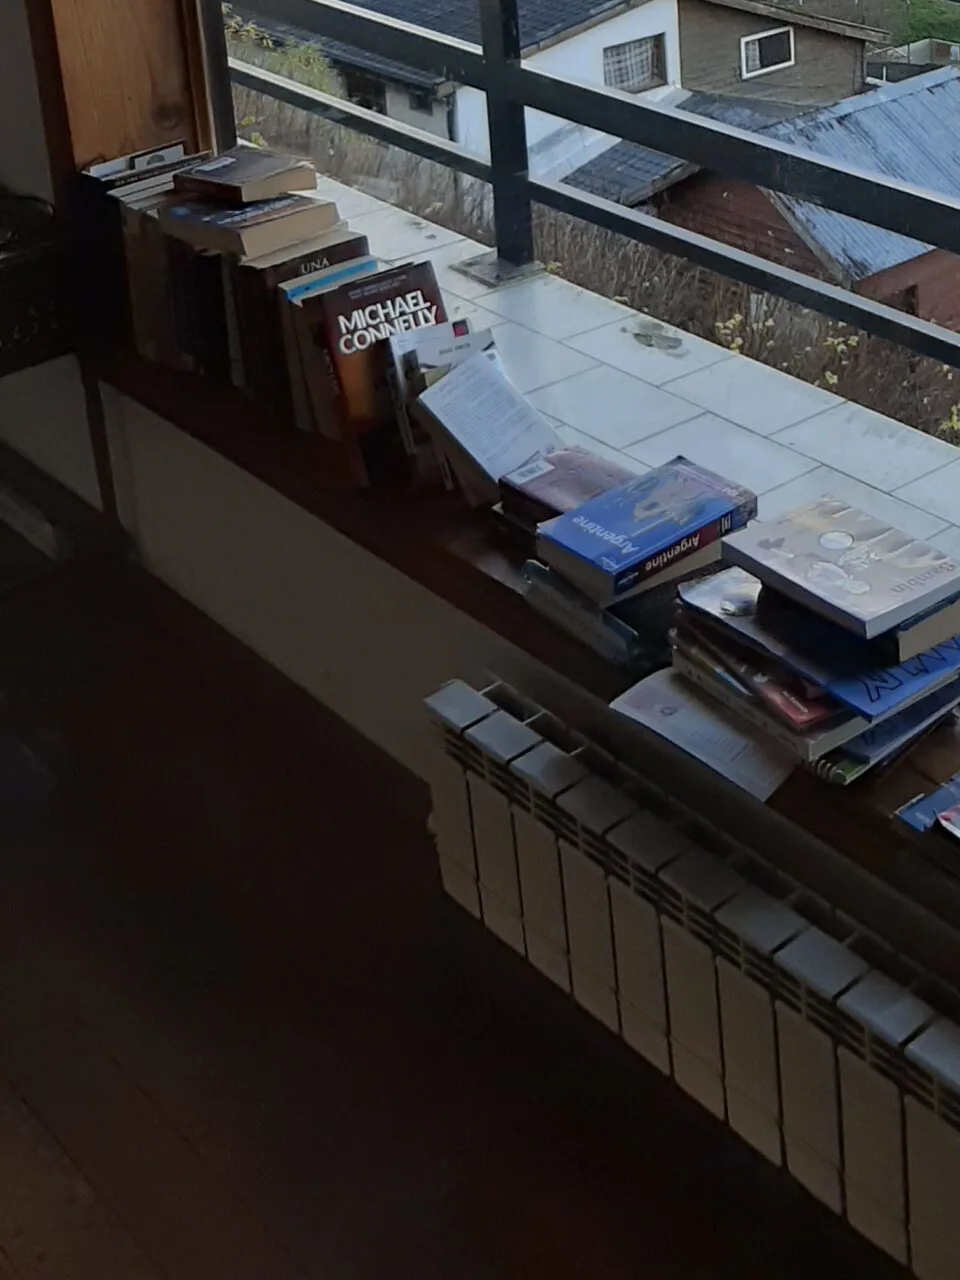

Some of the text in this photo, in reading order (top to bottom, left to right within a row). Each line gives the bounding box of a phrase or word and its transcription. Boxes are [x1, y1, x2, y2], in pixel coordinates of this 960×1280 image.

[301, 258, 330, 274] UNA
[337, 290, 431, 334] MICHAEL
[572, 515, 639, 554] Argentine
[645, 533, 701, 571] Argentine
